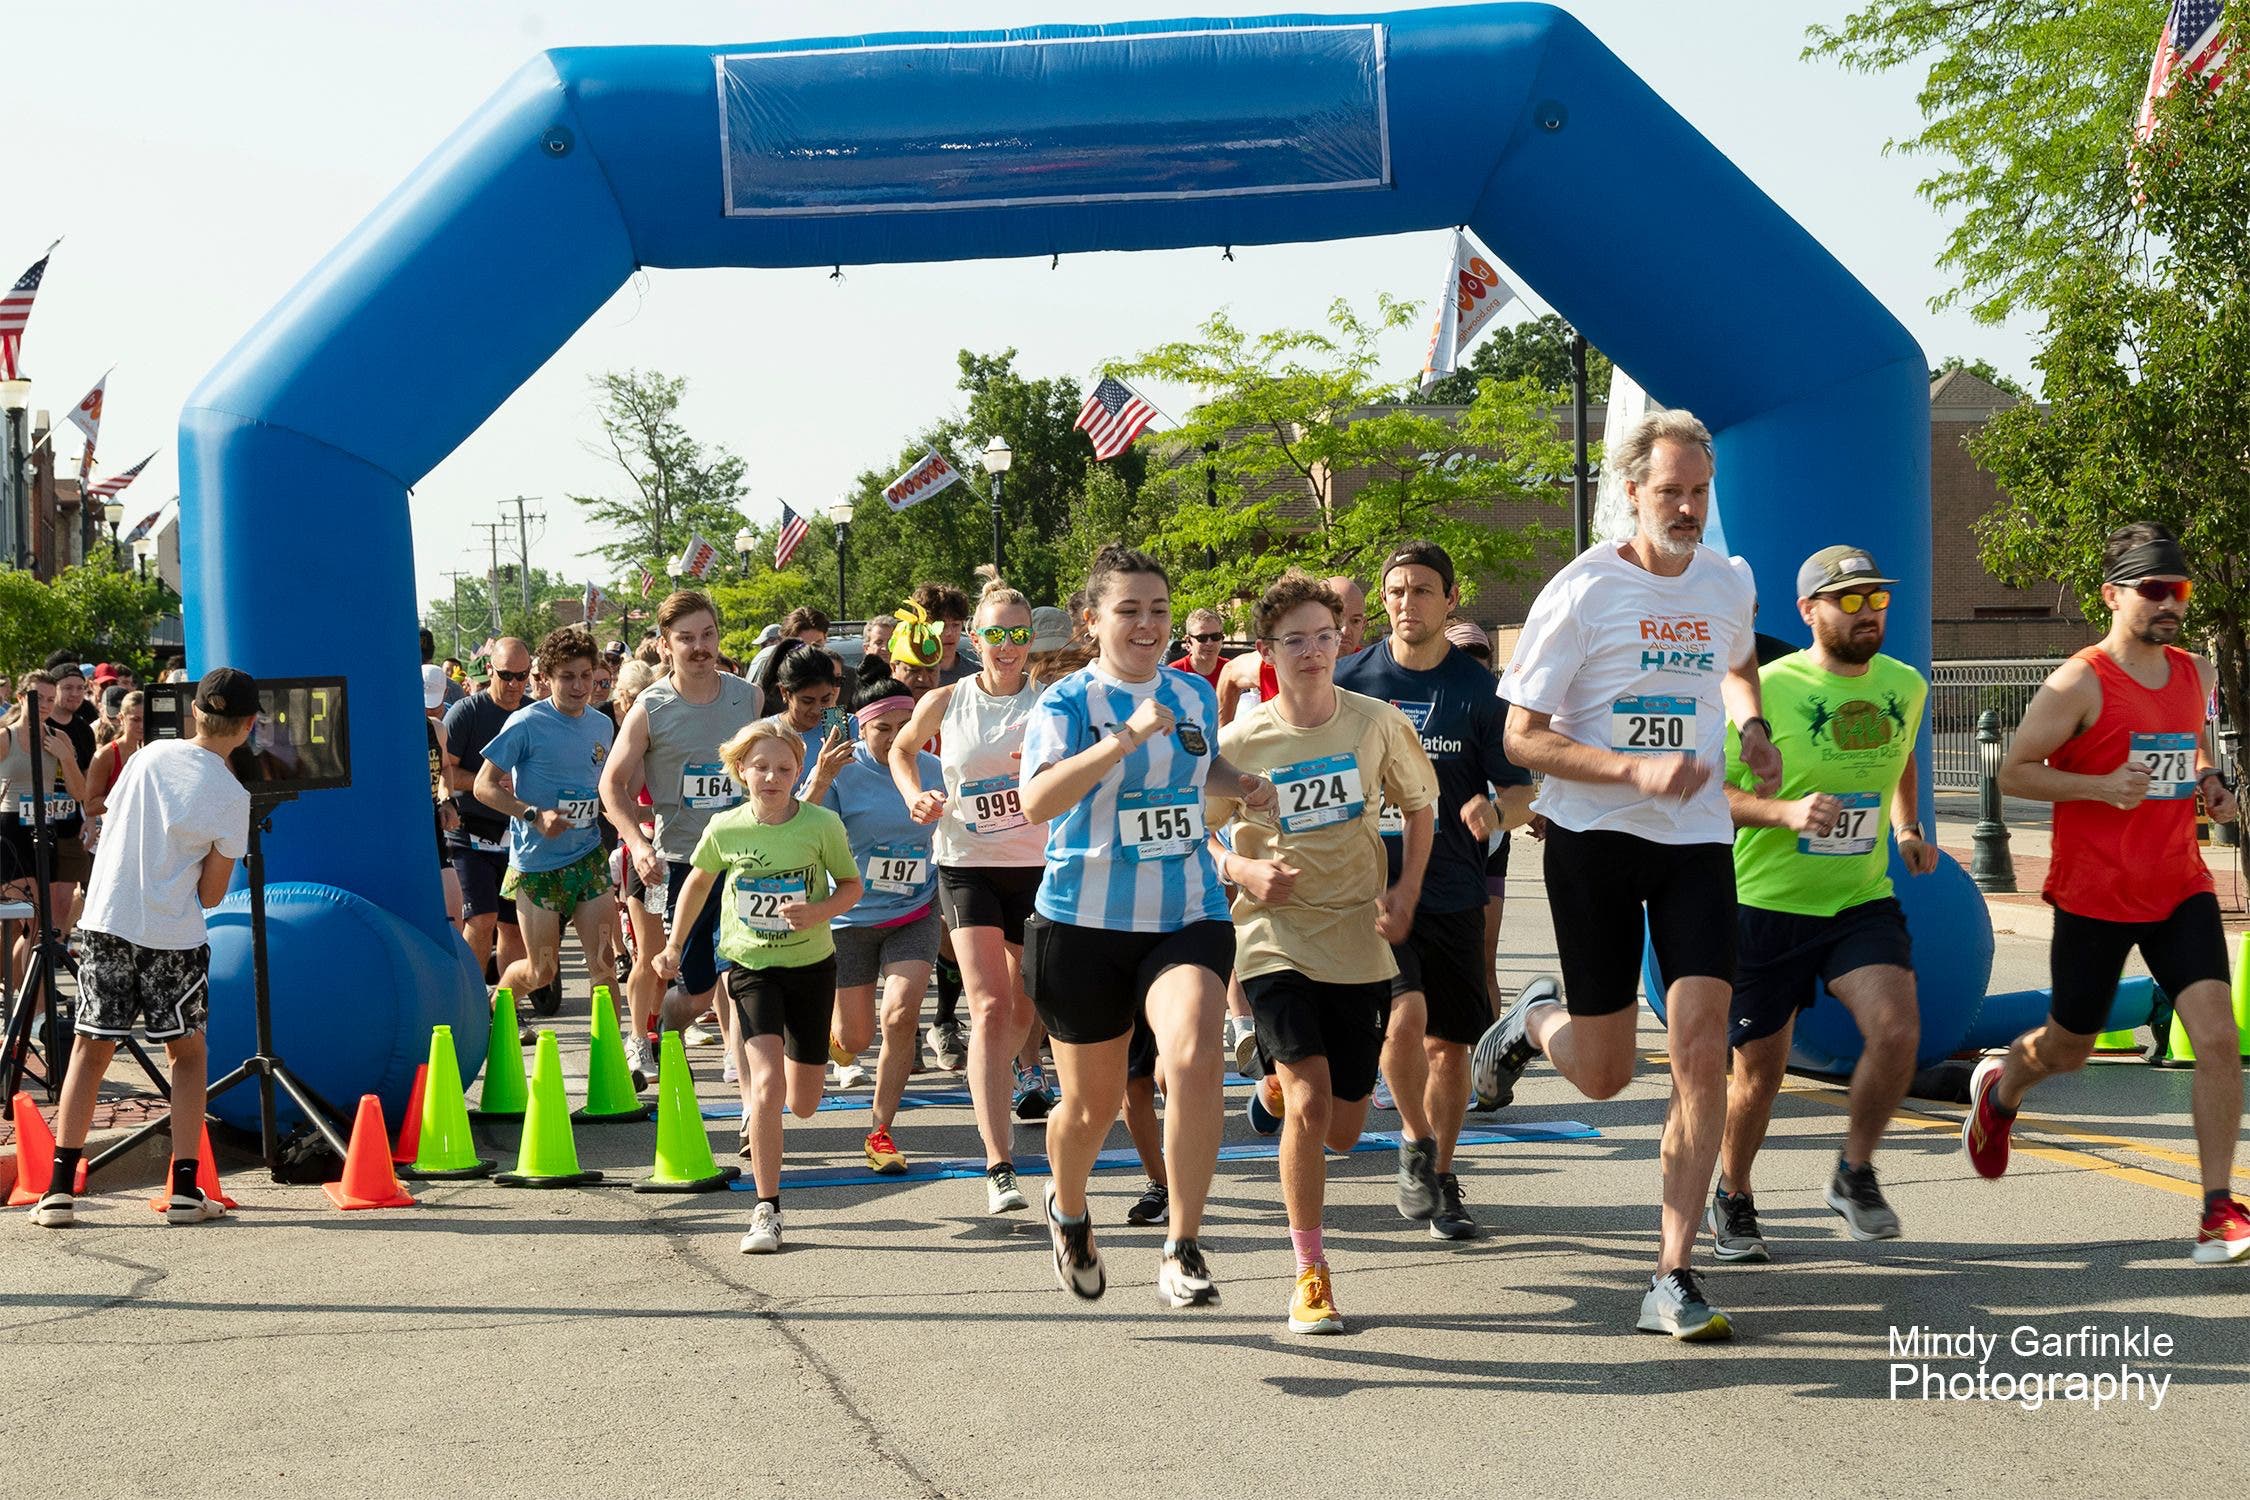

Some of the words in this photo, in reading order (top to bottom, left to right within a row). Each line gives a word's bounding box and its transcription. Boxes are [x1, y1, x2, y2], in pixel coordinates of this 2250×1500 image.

[1638, 619, 1711, 642] RACE
[1648, 641, 1707, 653] AGAINST
[1640, 650, 1715, 672] HATE
[1628, 716, 1683, 747] 250
[1420, 734, 1462, 753] ation
[2145, 752, 2186, 780] 278
[696, 777, 733, 797] 164
[1289, 775, 1347, 813] 224
[24, 802, 53, 816] 19
[567, 801, 594, 819] 274
[975, 790, 1021, 820] 999
[1137, 808, 1191, 841] 155
[1816, 810, 1868, 838] 97
[879, 860, 918, 882] 197
[750, 894, 793, 918] 22
